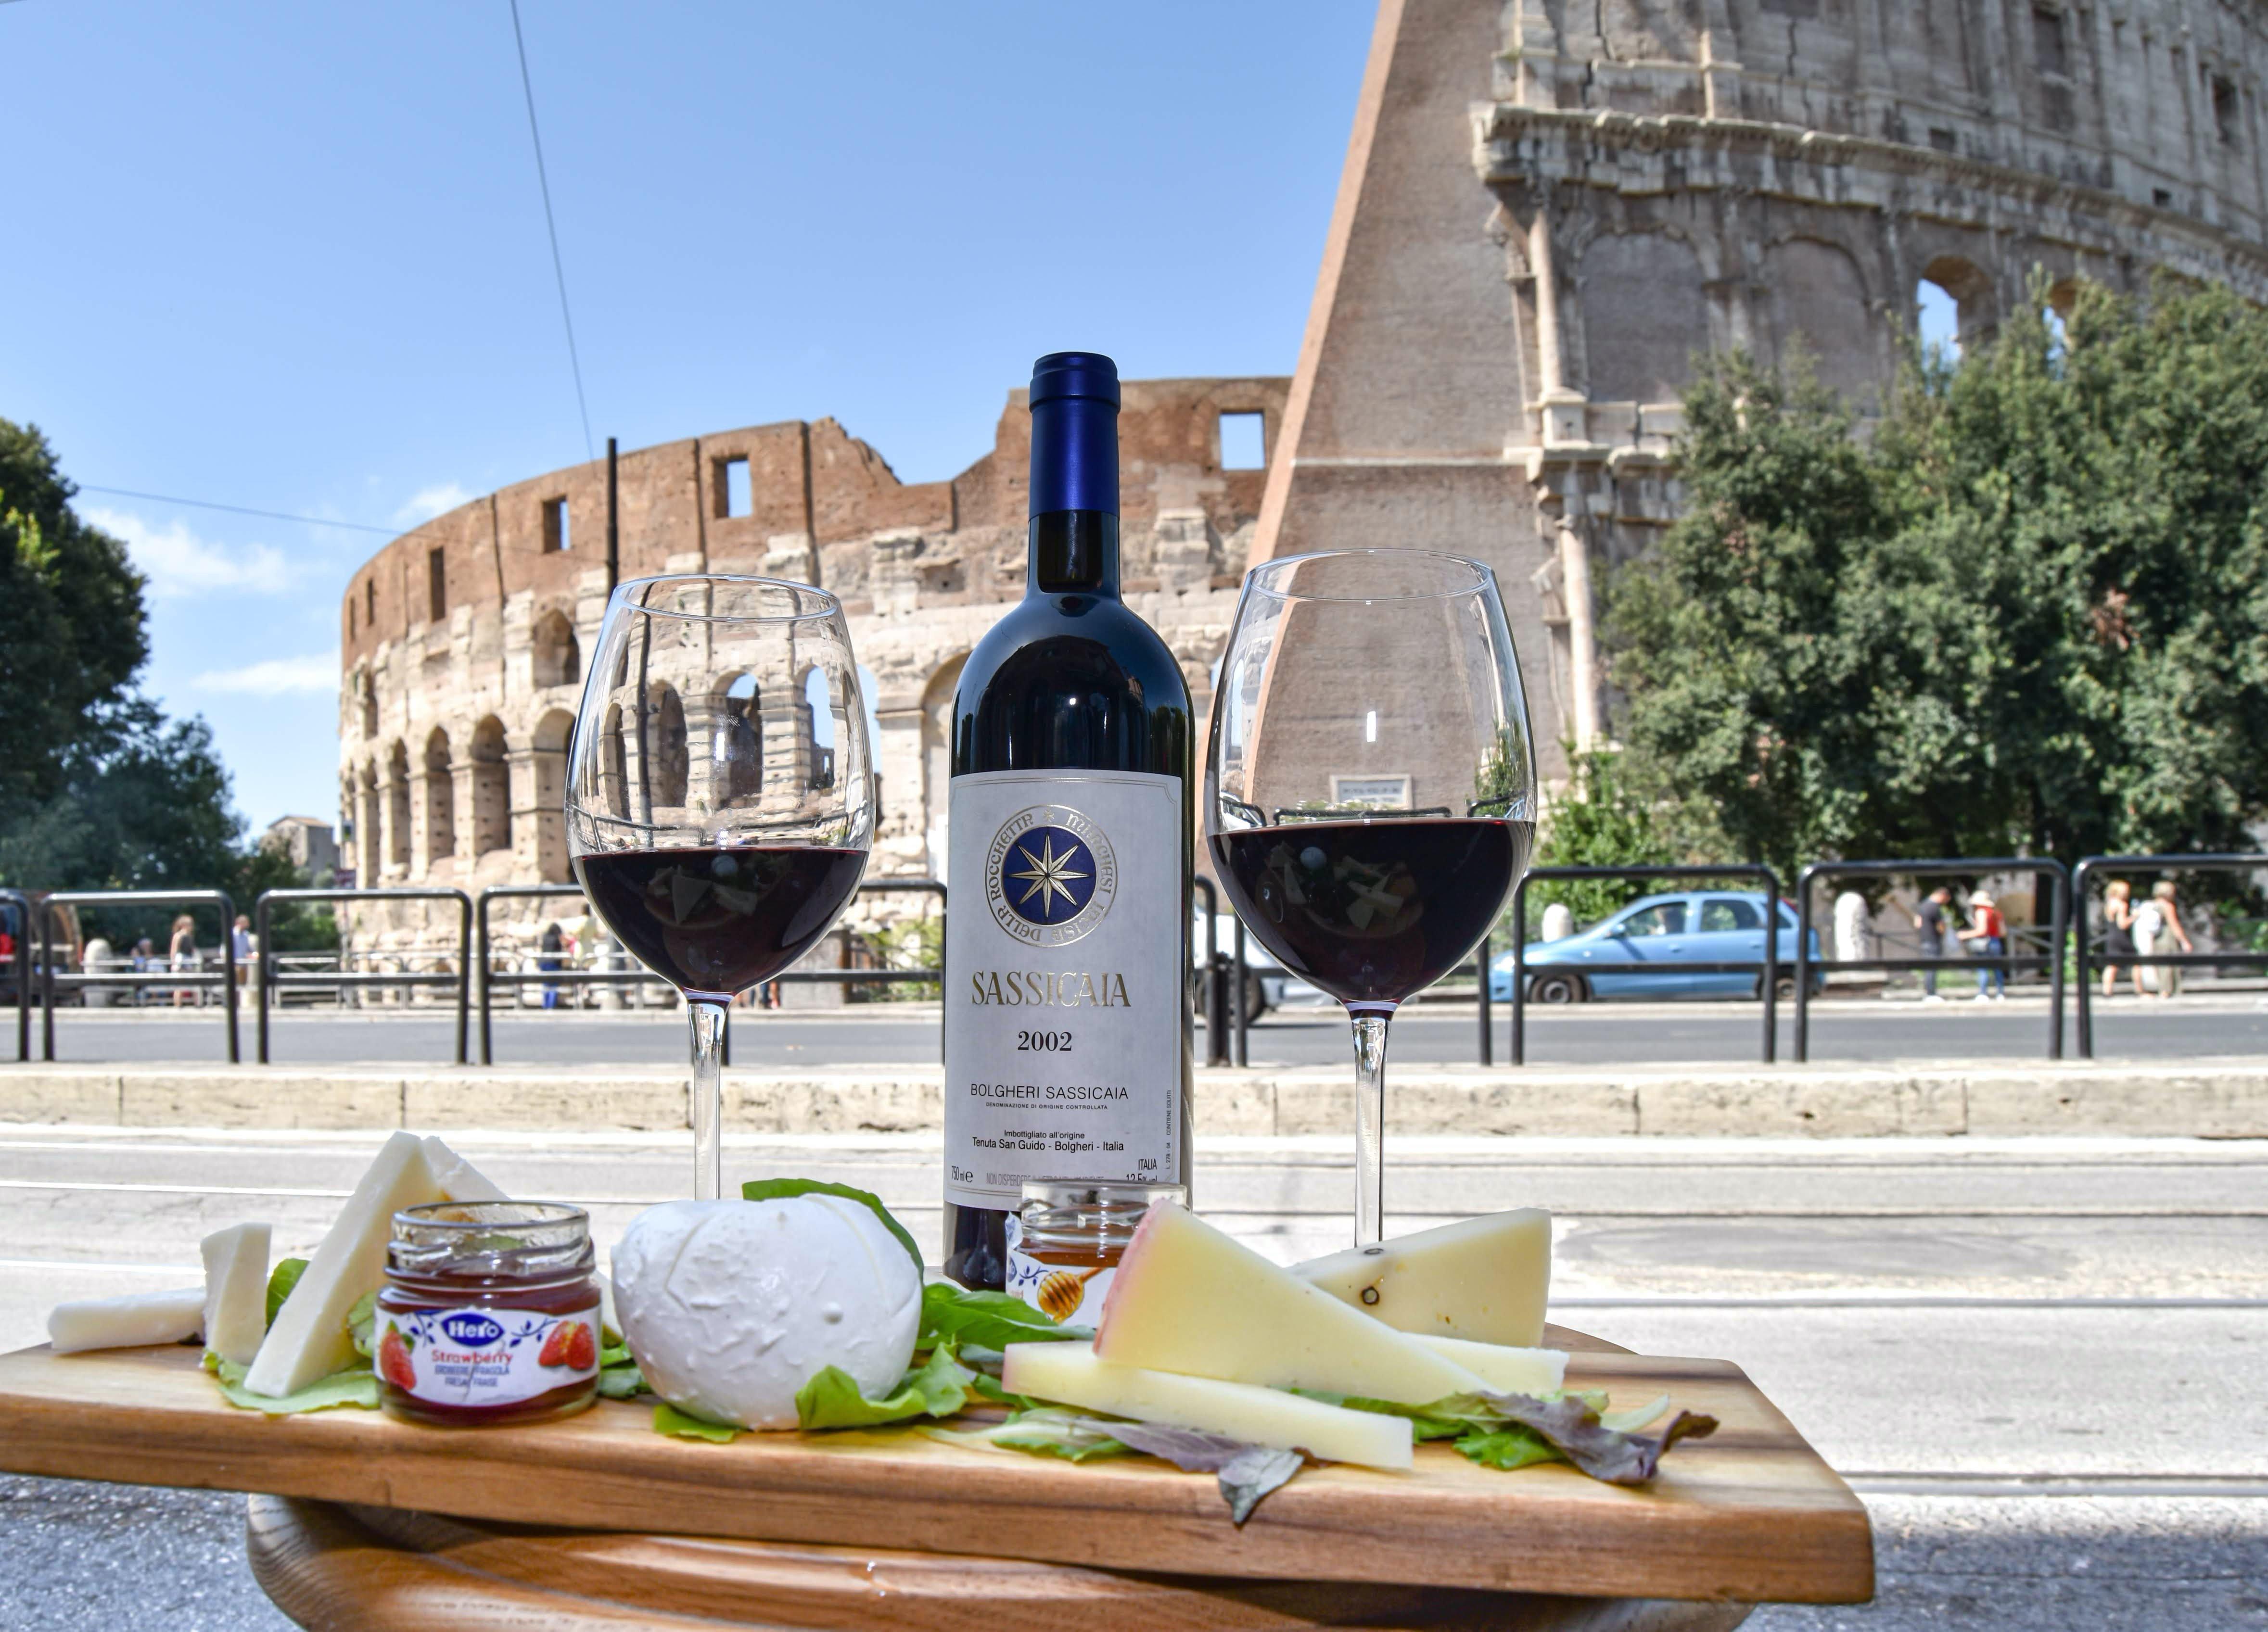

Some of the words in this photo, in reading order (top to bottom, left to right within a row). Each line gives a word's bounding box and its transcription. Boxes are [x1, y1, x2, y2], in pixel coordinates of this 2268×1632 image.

[989, 813, 1034, 902] ROCCHETTA
[997, 905, 1042, 941] DELLA
[972, 970, 1132, 1007] SASSICAIA
[1017, 1031, 1073, 1052] 2002
[971, 1083, 1040, 1099] BOLGHERI
[1045, 1086, 1129, 1100] SASSICAIA
[1004, 1129, 1047, 1140] Imbottigliato
[1049, 1131, 1085, 1141] all'origine
[972, 1137, 997, 1149] Tenuta
[998, 1139, 1016, 1150] San
[1018, 1139, 1046, 1151] Guido
[1055, 1141, 1094, 1154] Bolgheri
[1103, 1141, 1124, 1151] Italia
[1138, 1158, 1157, 1171] ITALIA
[986, 1172, 997, 1185] NON
[448, 1320, 499, 1339] Hero
[432, 1349, 513, 1365] Strawberry
